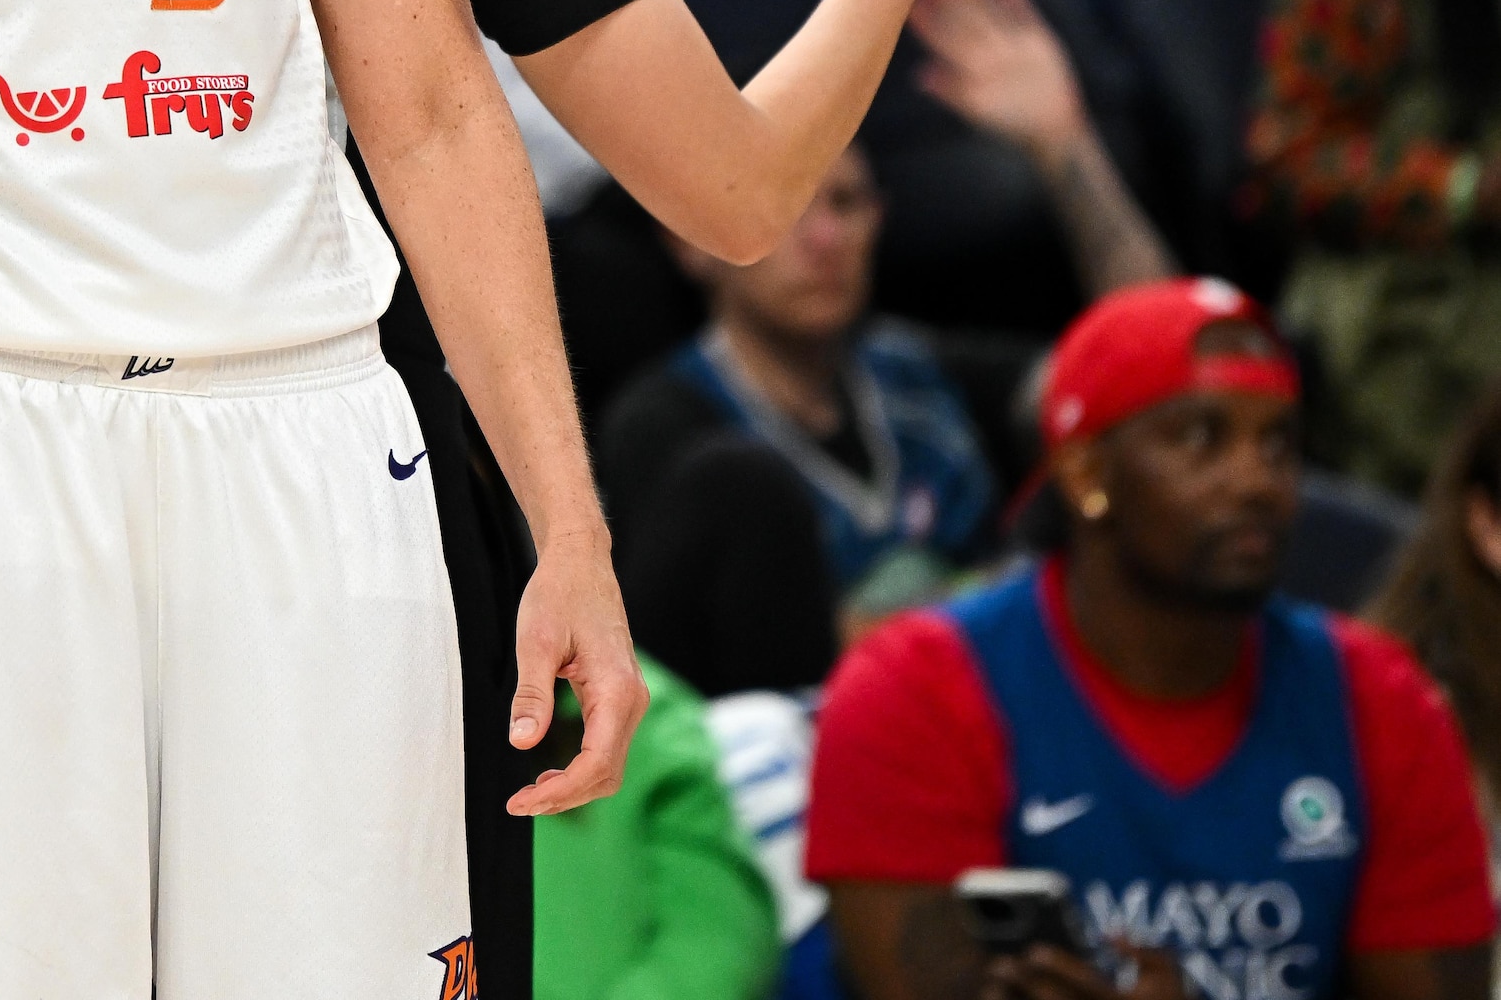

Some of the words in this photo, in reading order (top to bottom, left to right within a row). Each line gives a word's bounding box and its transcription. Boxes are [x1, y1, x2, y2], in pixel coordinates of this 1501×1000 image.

[102, 50, 254, 139] fry's
[147, 78, 191, 94] FOOD
[196, 76, 246, 90] STORES
[1086, 880, 1303, 948] MAYO
